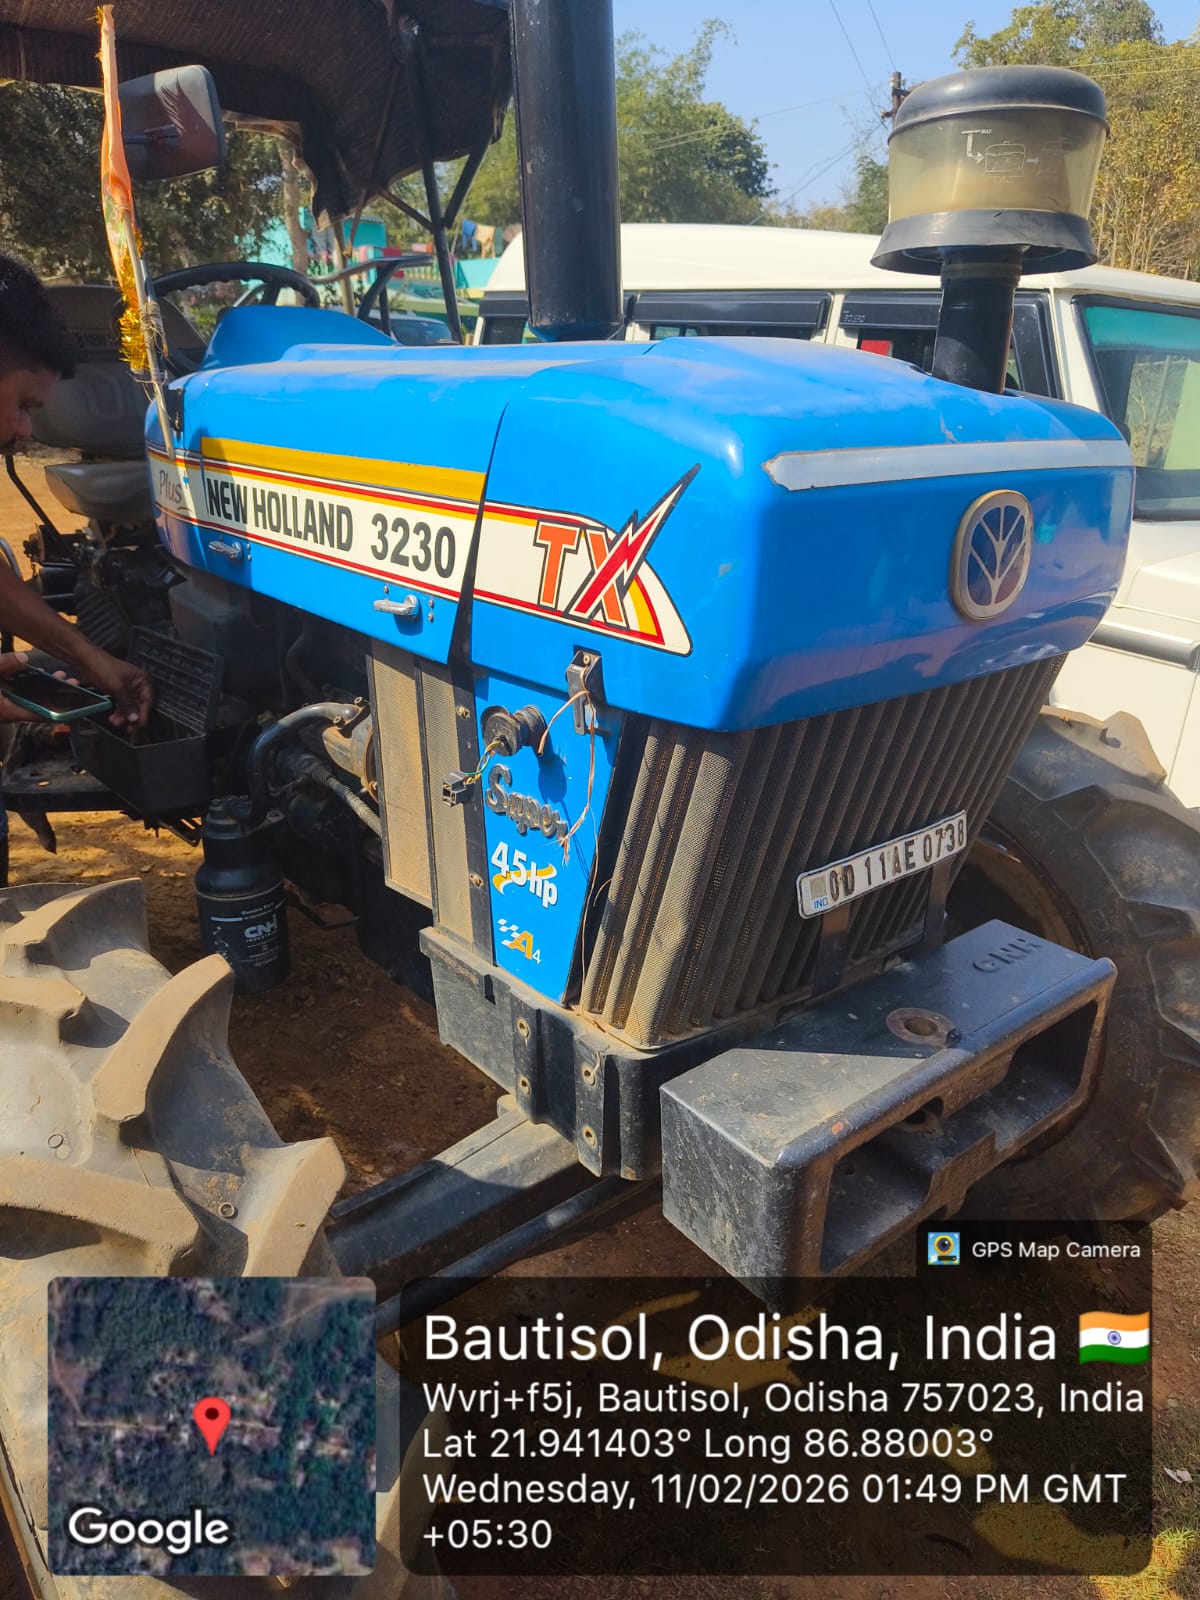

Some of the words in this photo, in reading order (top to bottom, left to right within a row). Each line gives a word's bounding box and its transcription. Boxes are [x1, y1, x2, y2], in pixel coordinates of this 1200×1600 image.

[159, 469, 182, 504] Plus
[206, 477, 248, 525] NEW
[252, 487, 354, 552] HOLLAND
[370, 512, 457, 579] 3230
[533, 463, 701, 631] TX
[485, 763, 569, 843] Super
[490, 840, 558, 908] 45hp
